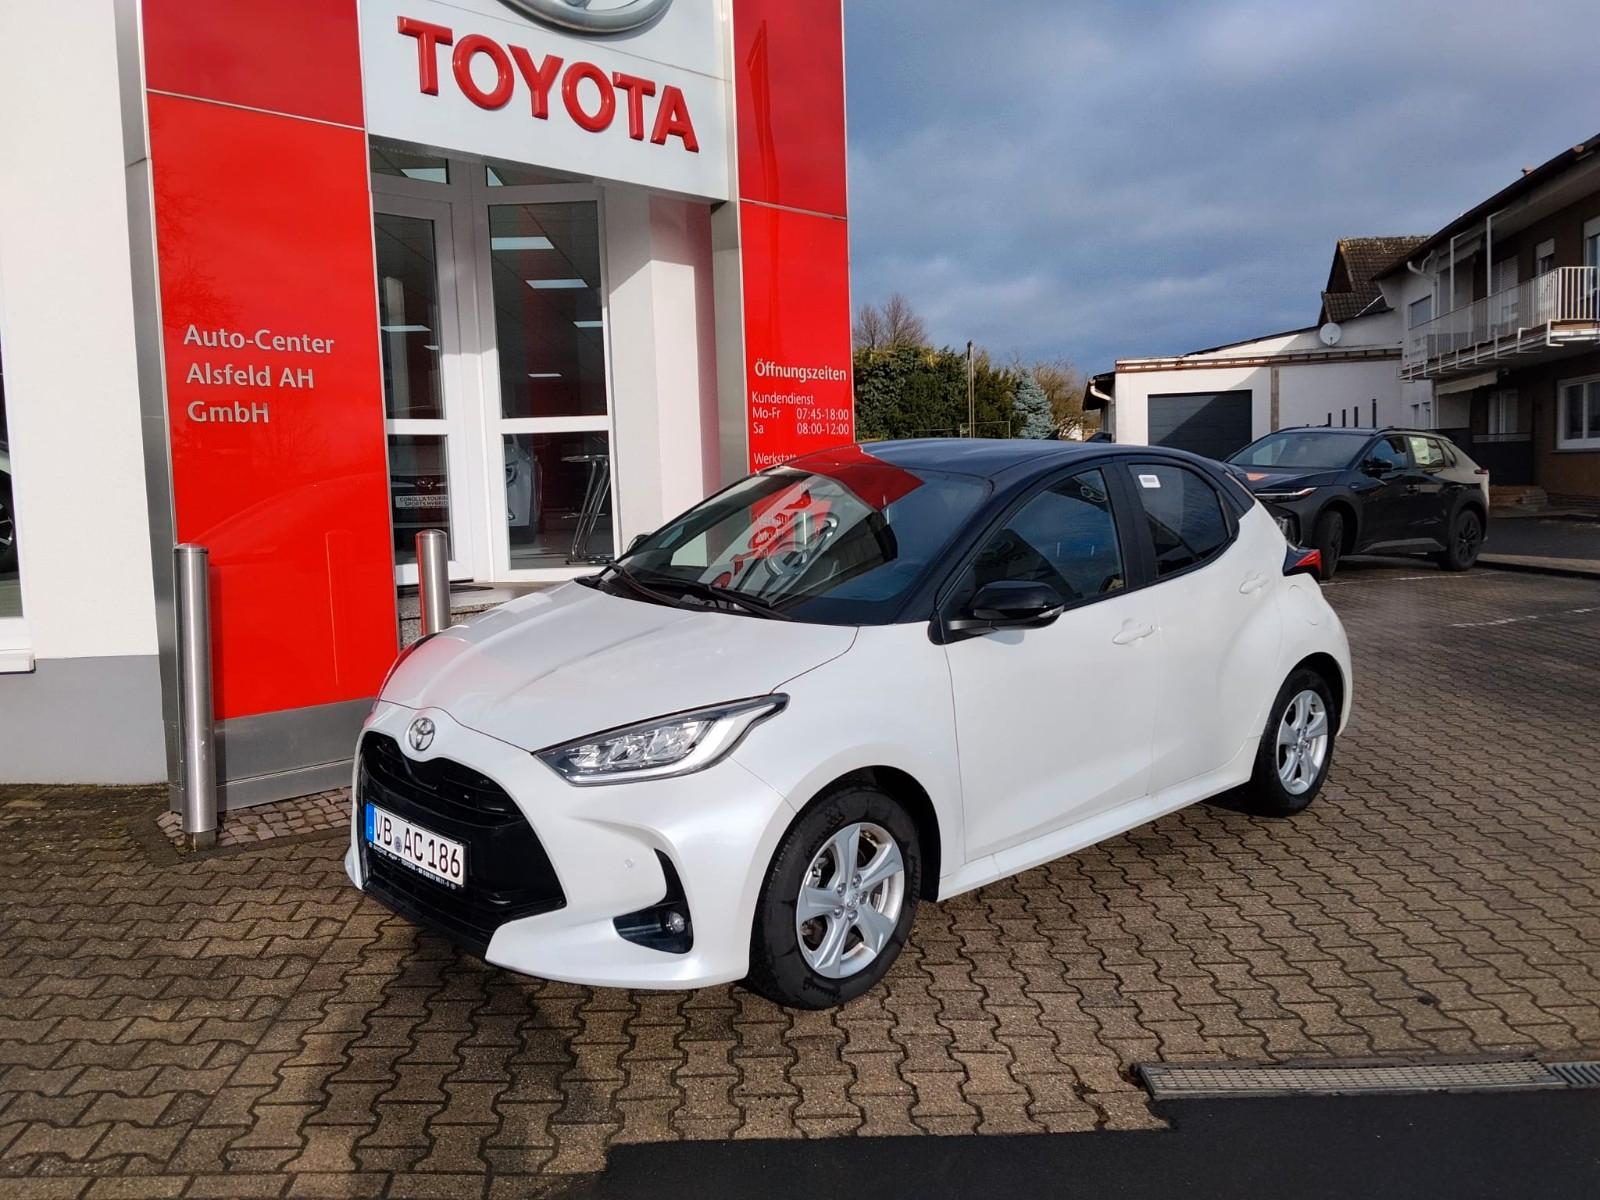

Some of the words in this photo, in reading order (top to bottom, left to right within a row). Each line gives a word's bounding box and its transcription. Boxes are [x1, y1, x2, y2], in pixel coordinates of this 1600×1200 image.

[397, 15, 699, 153] TOYOTA
[183, 324, 335, 354] Auto-Center
[186, 362, 272, 387] Alsfeld
[279, 367, 314, 389] AH
[754, 358, 847, 384] Öffnungszeiten
[751, 391, 815, 405] Kundendienst
[187, 400, 271, 423] GmbH
[752, 406, 781, 419] Mo-Fr
[796, 407, 849, 420] 07:45-18:00
[753, 422, 765, 434] Sa
[796, 422, 850, 435] 08:00-12:00
[753, 453, 798, 465] Werksta
[375, 812, 393, 846] VB
[404, 827, 423, 862] AC
[427, 838, 461, 878] 186
